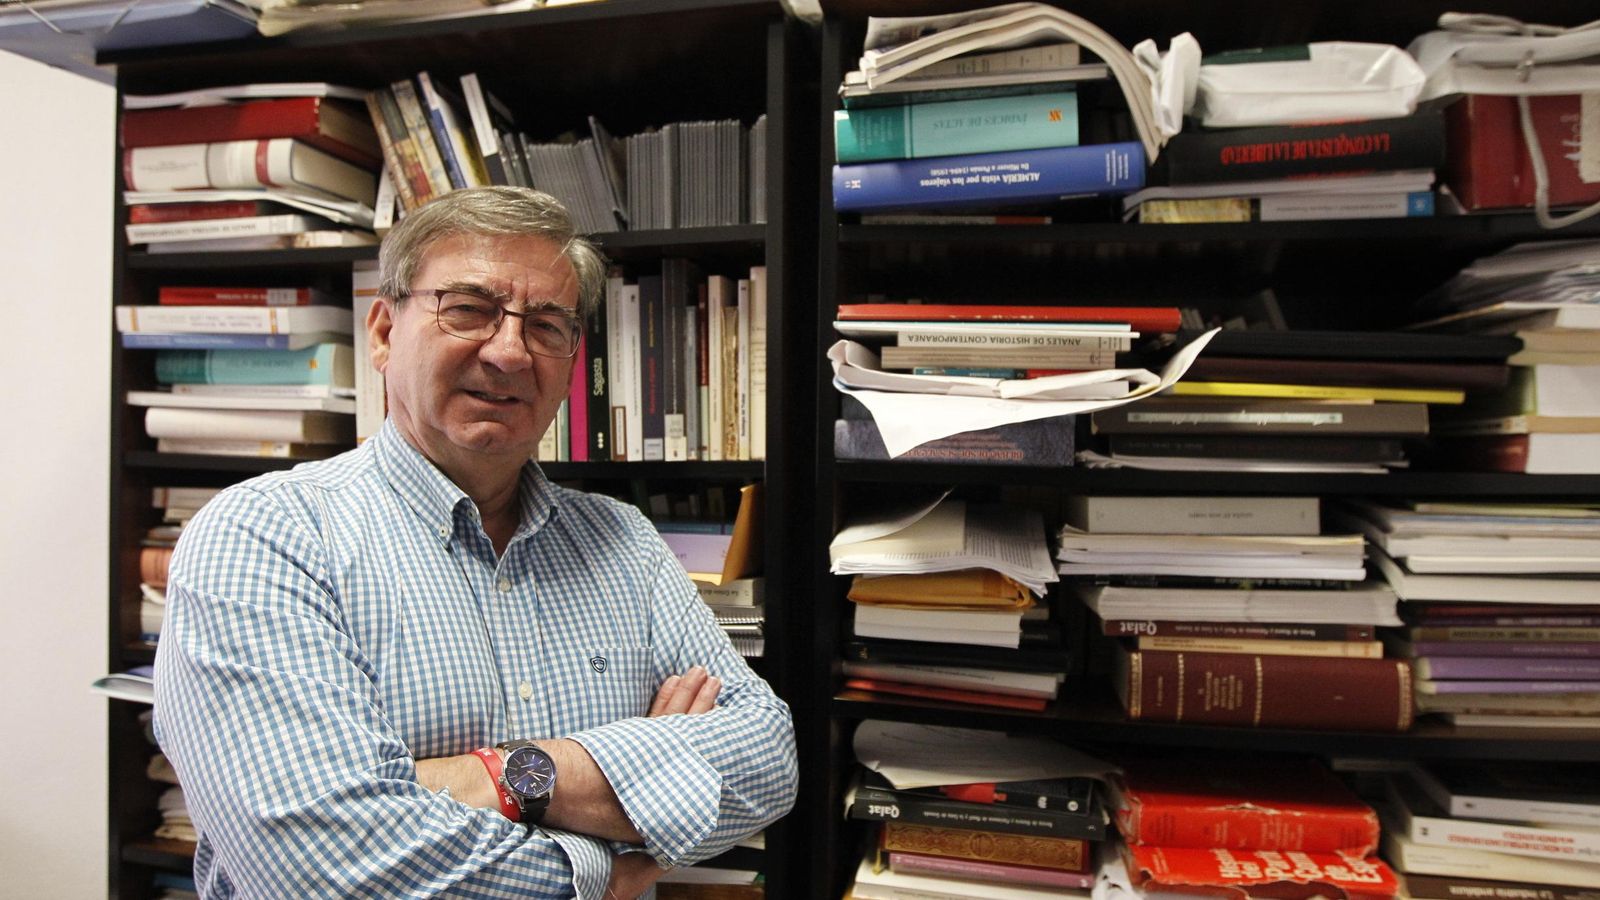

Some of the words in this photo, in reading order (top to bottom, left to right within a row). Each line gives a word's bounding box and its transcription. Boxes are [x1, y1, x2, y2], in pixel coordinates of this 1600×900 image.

[933, 119, 964, 130] ACTAS
[969, 116, 981, 127] DE
[1309, 132, 1373, 160] CONQUISTA
[1374, 132, 1390, 152] LA
[1220, 142, 1274, 166] LIBERTAD
[1275, 141, 1290, 161] LA
[1292, 139, 1308, 160] DE
[1020, 162, 1030, 171] De
[920, 177, 951, 188] viajeros
[952, 176, 965, 187] los
[966, 174, 980, 184] por
[981, 174, 1001, 184] vista
[1002, 172, 1041, 185] ALMERÍA
[990, 335, 1031, 345] HISTORIA
[1033, 336, 1046, 346] DE
[1047, 336, 1082, 347] ANALES
[593, 357, 605, 396] Sagasta
[1120, 621, 1158, 636] Qalat
[868, 804, 900, 819] Qalat
[1236, 860, 1263, 879] del
